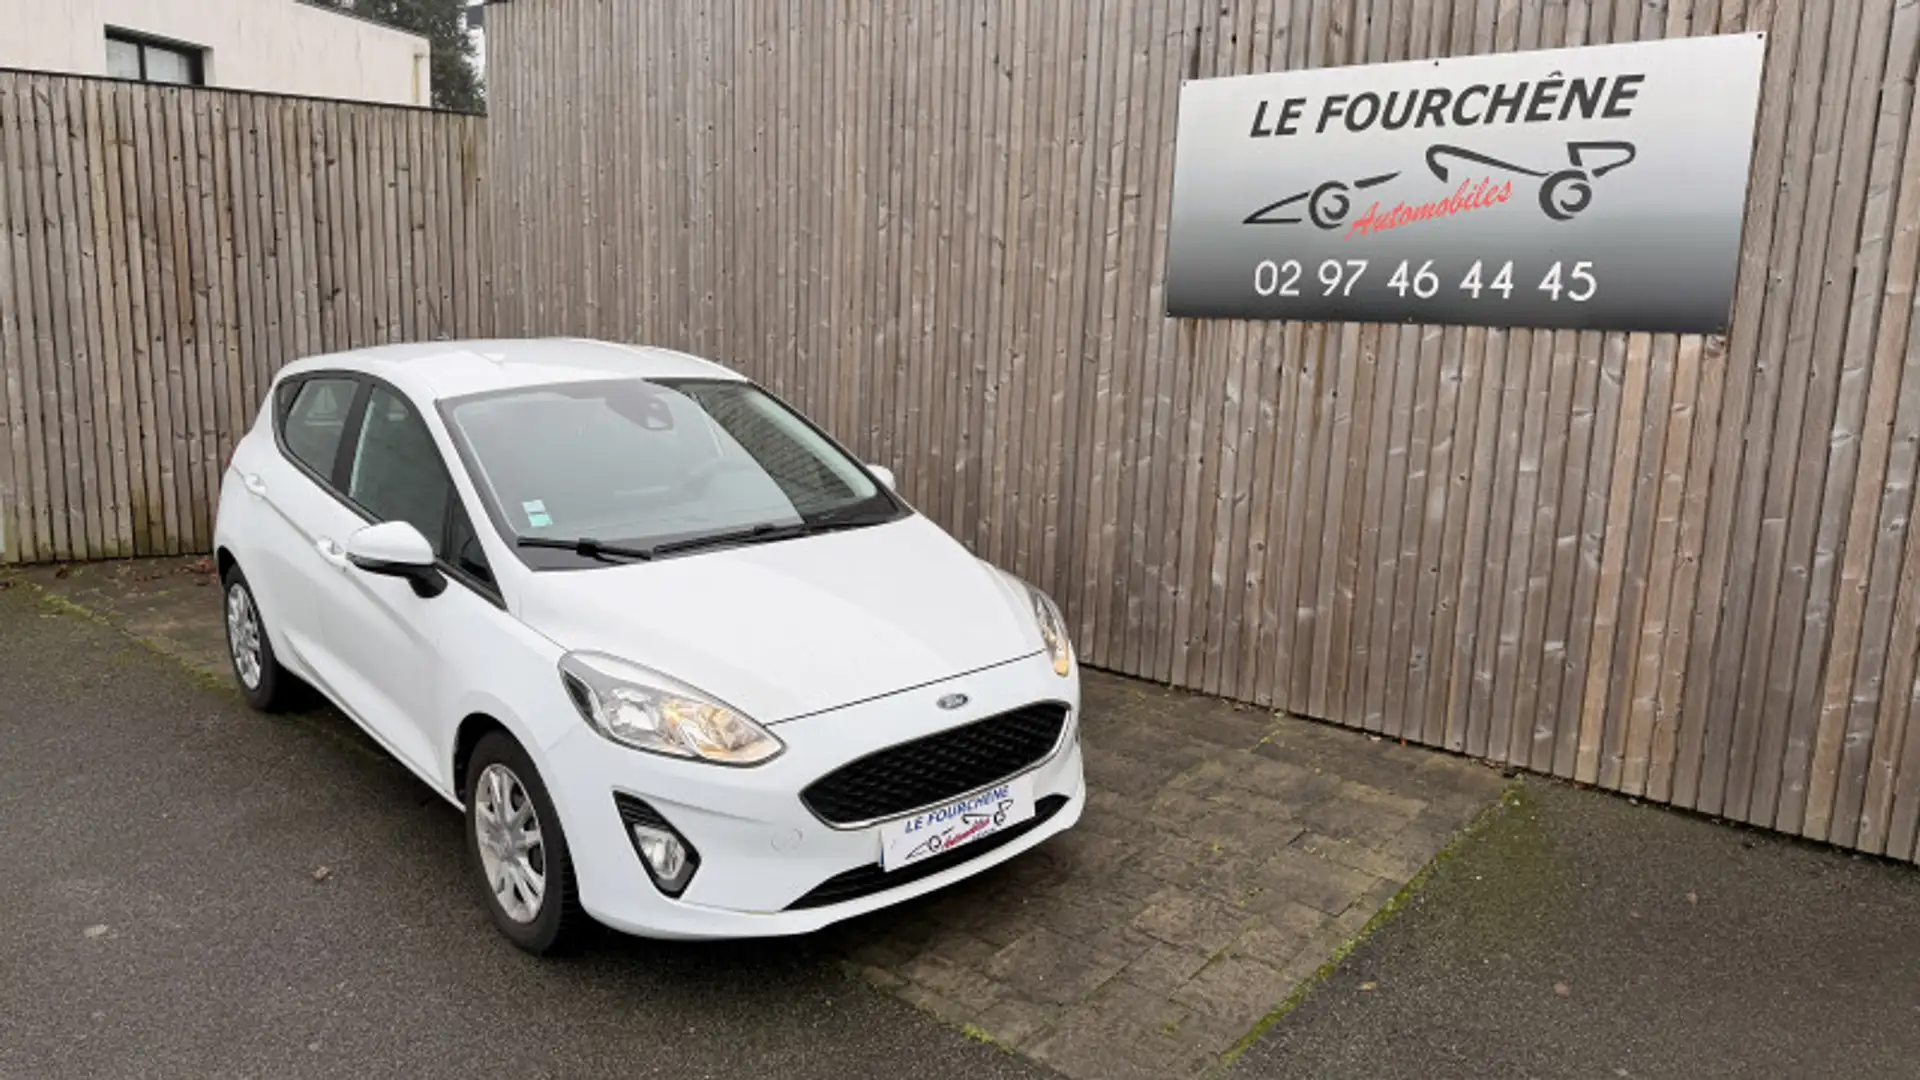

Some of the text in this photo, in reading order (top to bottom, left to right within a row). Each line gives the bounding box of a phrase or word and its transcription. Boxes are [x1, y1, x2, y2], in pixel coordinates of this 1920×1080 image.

[1250, 70, 1646, 137] LE FOURCHÊNE
[1344, 176, 1512, 242] Automobiles
[1254, 258, 1598, 302] 02 97 46 44 45
[905, 818, 923, 834] LE
